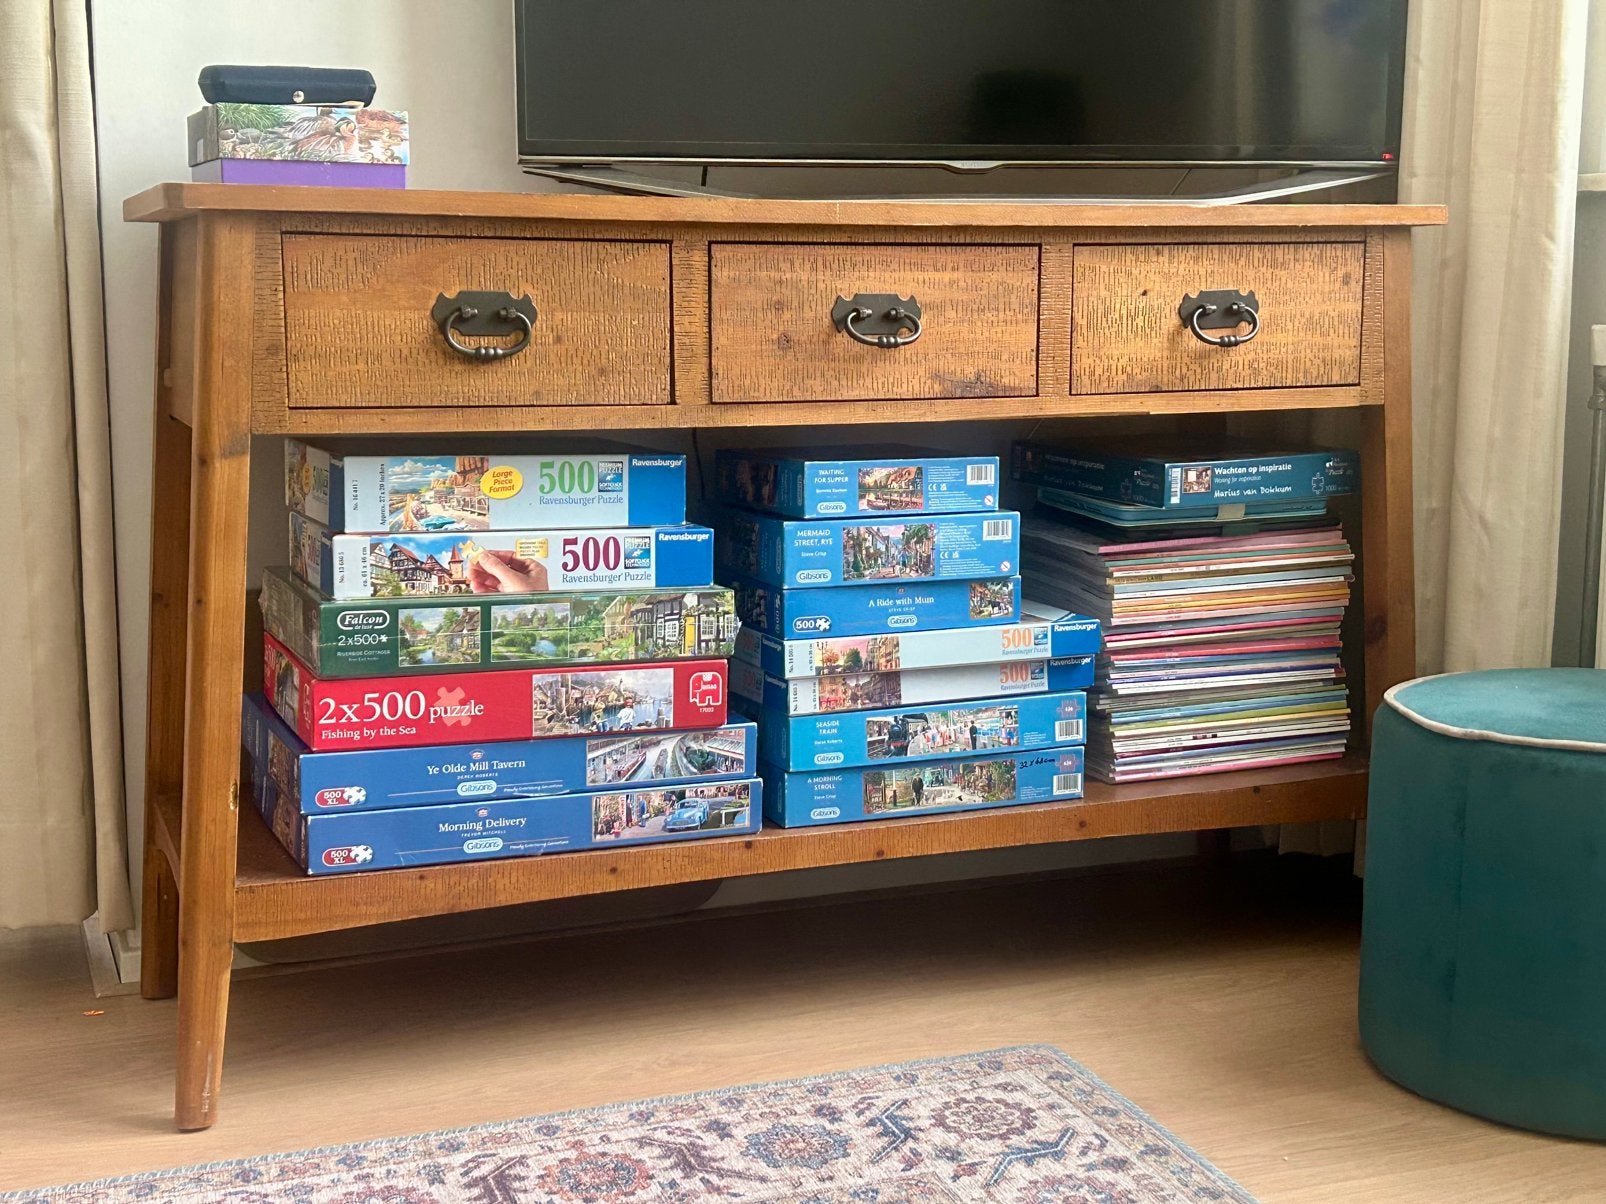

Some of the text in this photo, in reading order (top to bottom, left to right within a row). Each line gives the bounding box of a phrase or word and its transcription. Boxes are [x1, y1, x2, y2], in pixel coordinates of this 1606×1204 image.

[632, 459, 682, 468] Ravensburger
[1248, 466, 1257, 474] op
[1259, 463, 1292, 473] inspiratie
[538, 460, 595, 494] 500
[489, 484, 515, 493] Format
[1214, 489, 1240, 498] Marius
[1260, 486, 1292, 494] Dokkum
[539, 495, 624, 506] Ravensburger Puzzle
[658, 533, 709, 542] Ravensburger
[362, 546, 367, 555] cm
[562, 536, 620, 572] 500
[562, 572, 651, 584] Ravensburger Puzzle
[877, 598, 894, 606] Ride
[895, 597, 912, 605] with
[344, 614, 383, 625] Falcon
[796, 620, 814, 629] 500
[1054, 624, 1097, 632] Ravensburger
[1002, 627, 1032, 648] 500
[1050, 657, 1091, 666] Ravensburger
[1001, 662, 1029, 684] 500
[319, 690, 426, 724] 2x500
[429, 700, 484, 724] puzzle
[321, 726, 416, 740] Fishing by the Sea
[427, 760, 525, 775] Ye Olde Mill Tavern
[1020, 761, 1028, 769] 32
[461, 783, 494, 794] Gibsons
[439, 817, 527, 832] Morning Delivery
[467, 840, 500, 851] Gibsons
